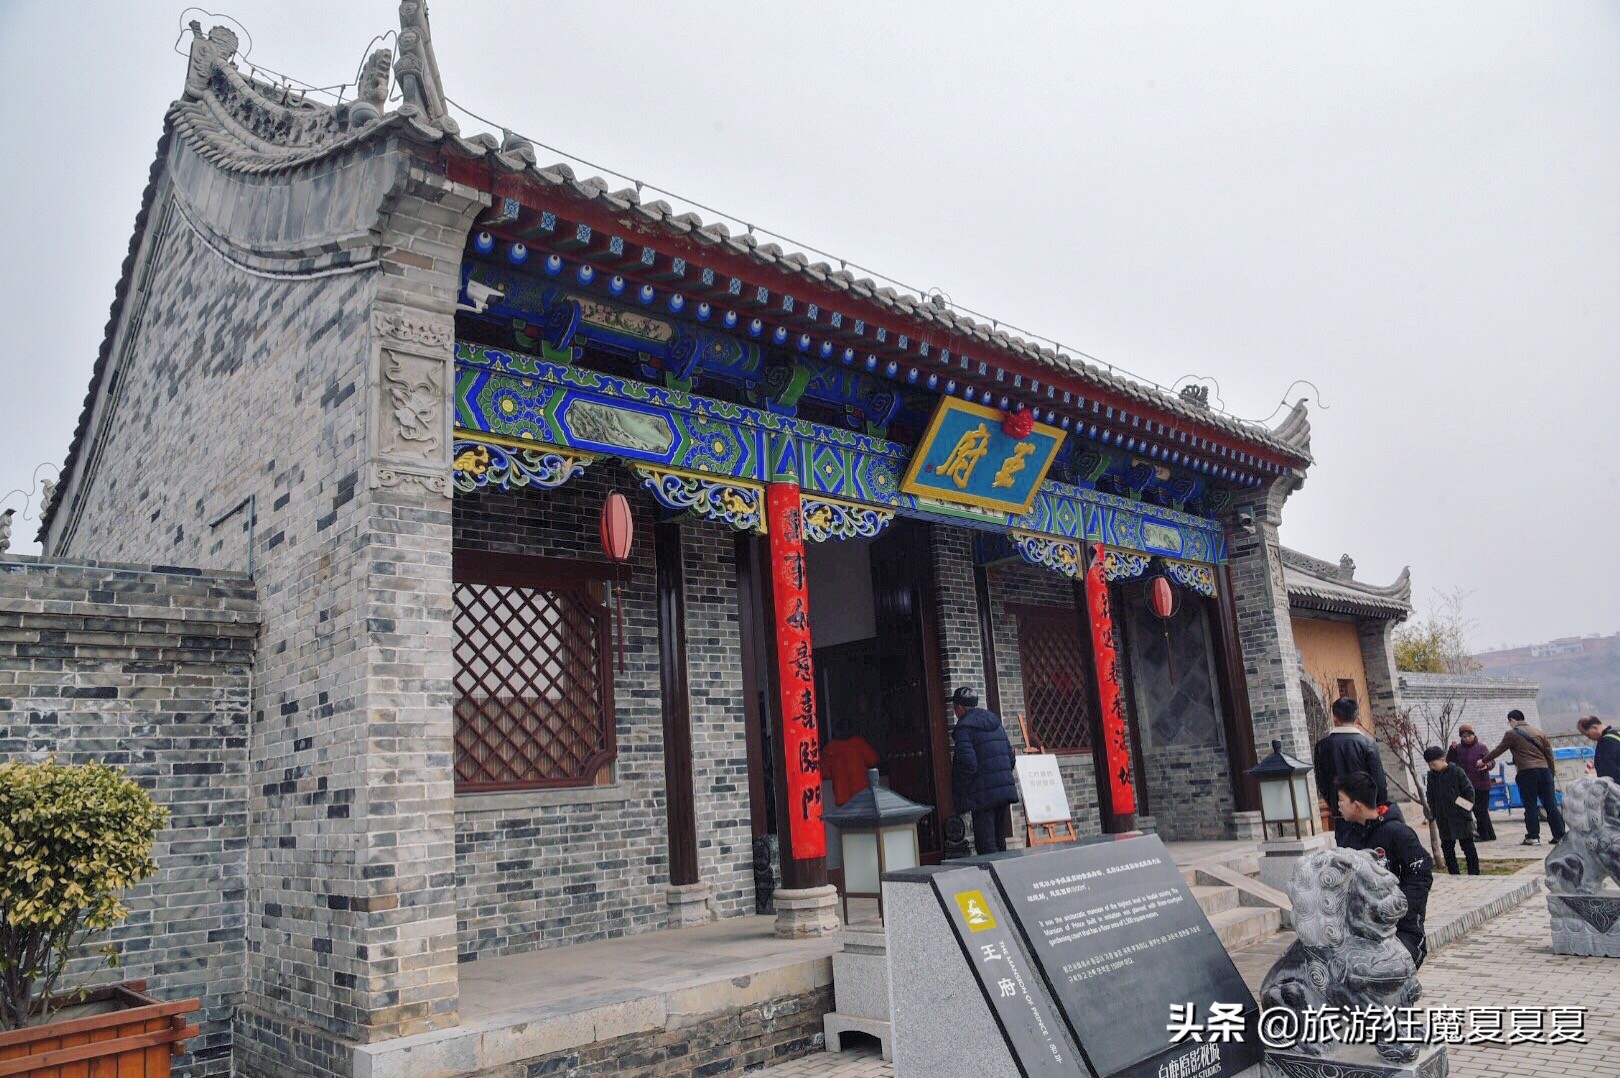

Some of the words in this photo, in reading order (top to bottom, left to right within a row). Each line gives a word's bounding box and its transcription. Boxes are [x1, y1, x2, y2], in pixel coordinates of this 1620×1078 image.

[980, 943, 1016, 998] 王府
[999, 940, 1009, 956] THE
[1006, 956, 1028, 994] MANSION
[1025, 994, 1034, 1006] OF
[1031, 1006, 1049, 1036] PRINCE
